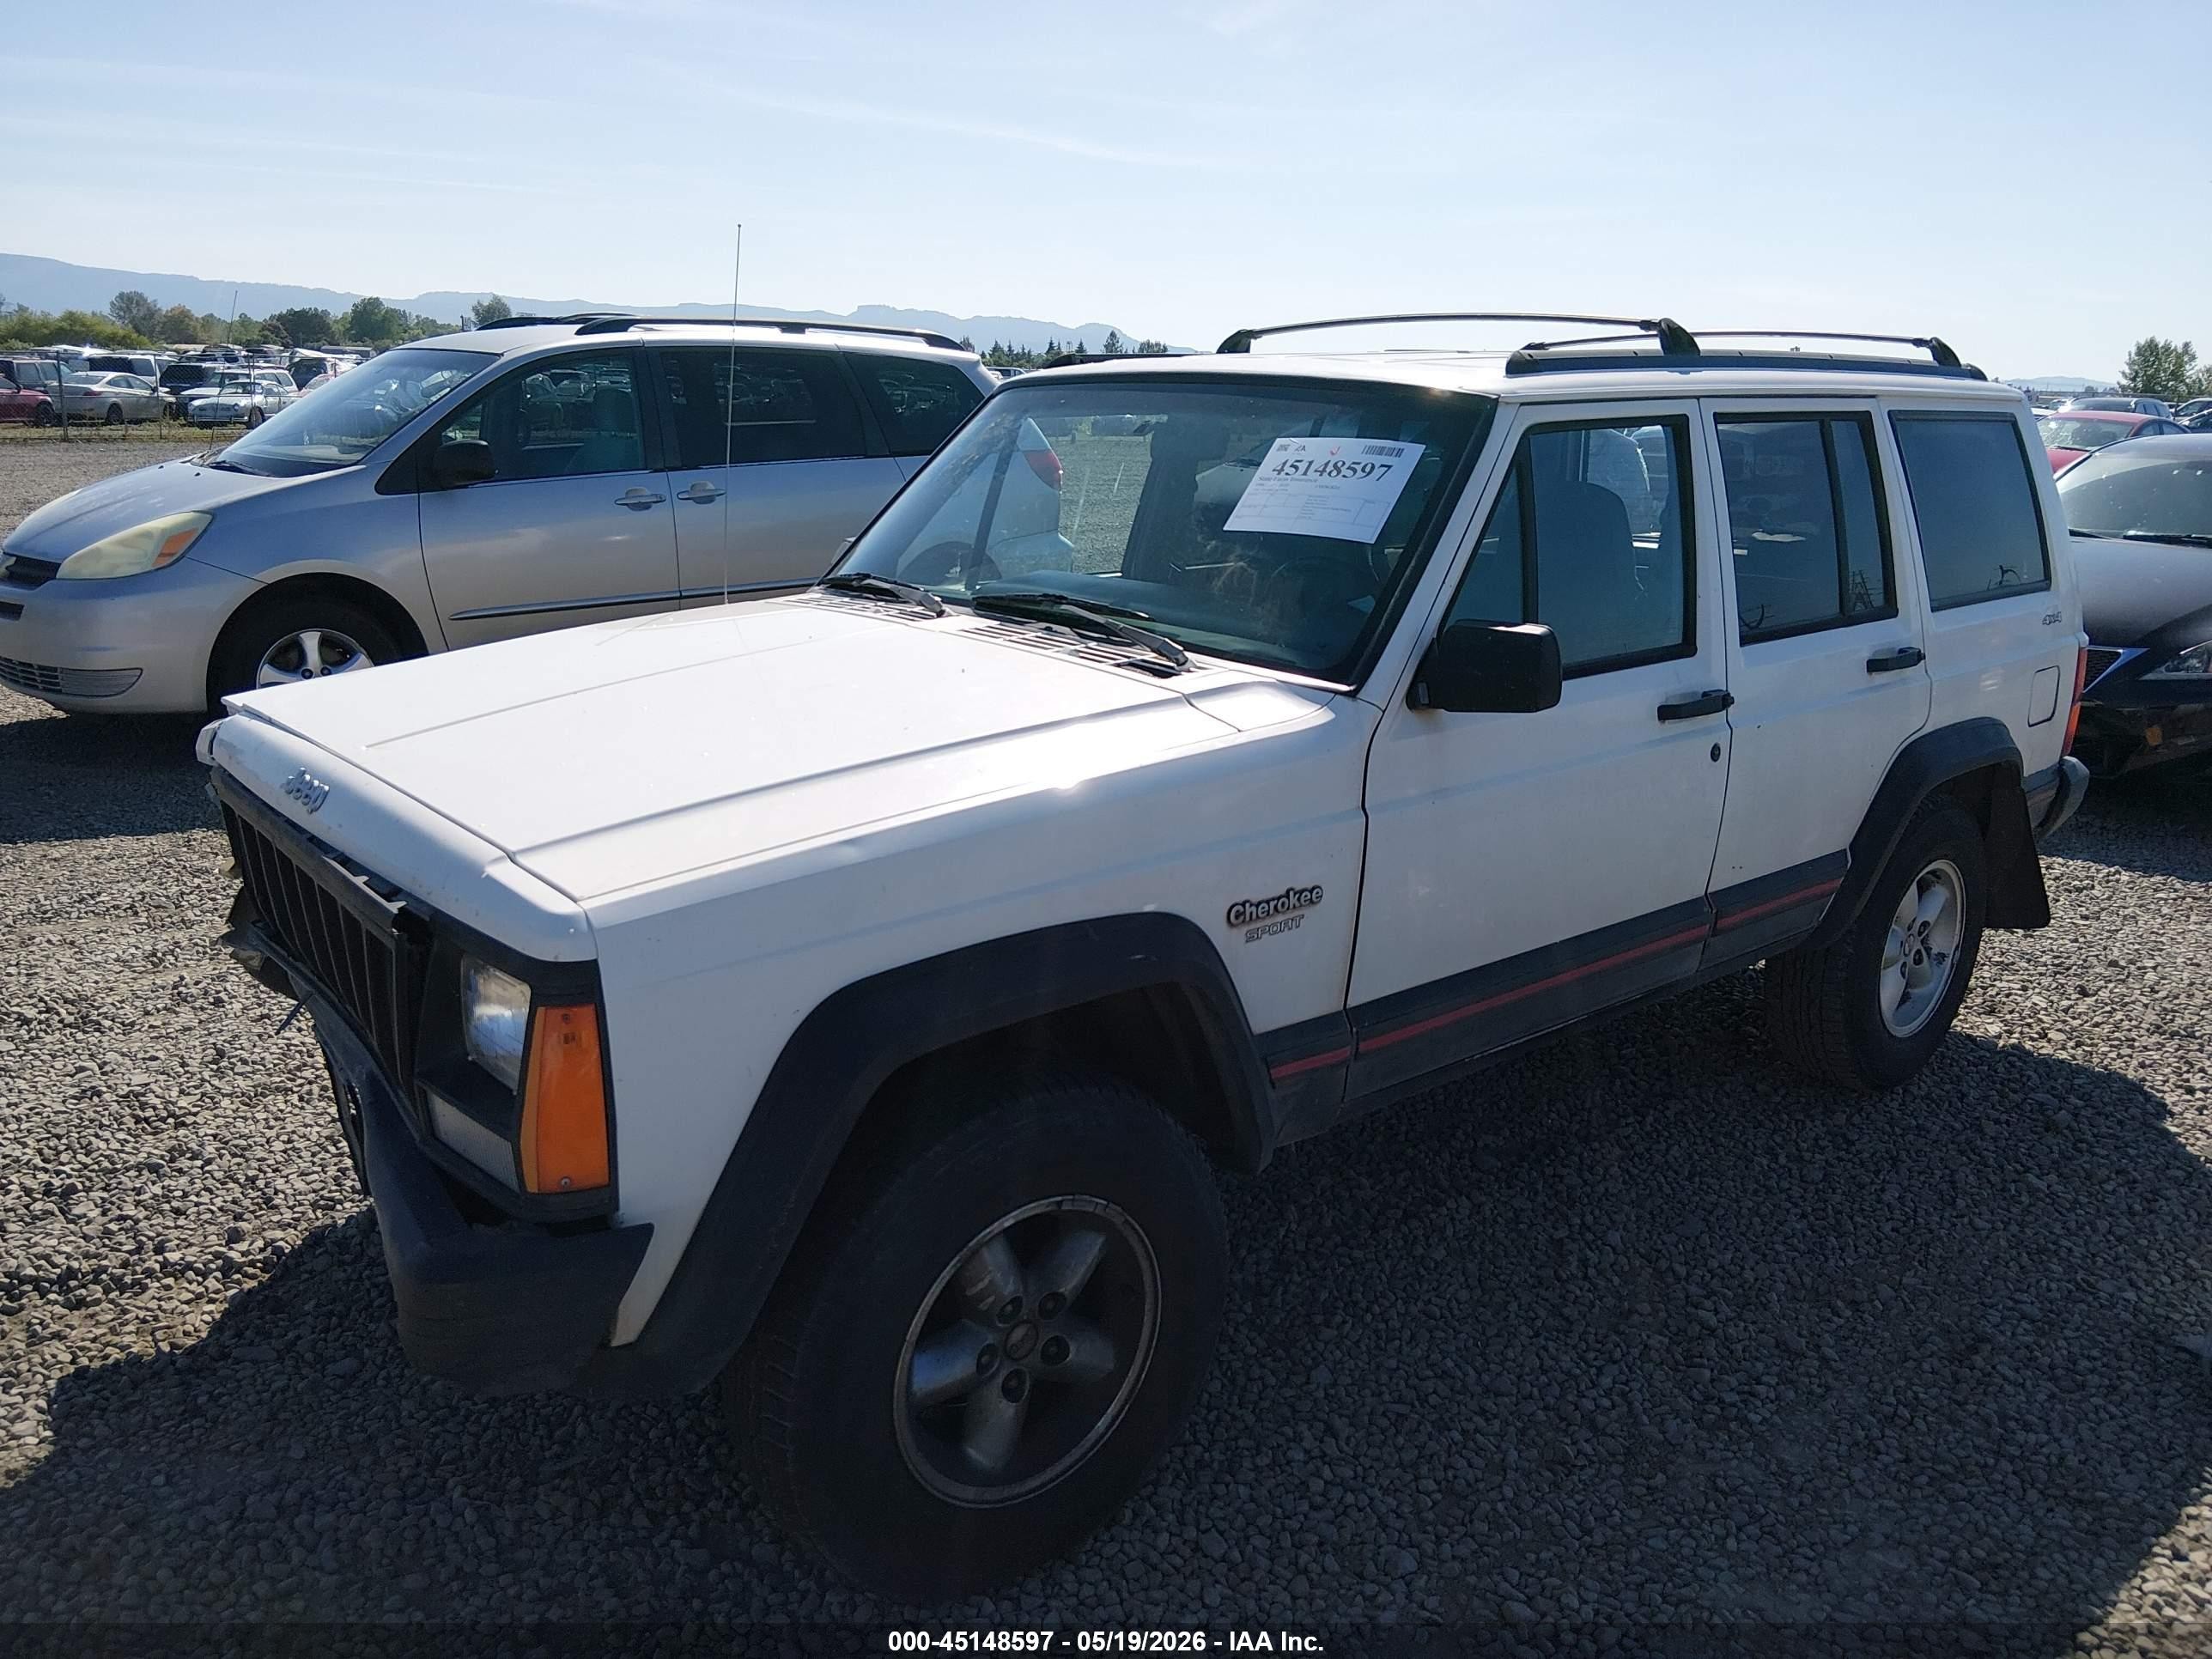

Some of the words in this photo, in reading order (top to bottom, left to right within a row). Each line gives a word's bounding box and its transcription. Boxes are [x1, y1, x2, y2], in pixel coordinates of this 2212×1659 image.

[1272, 459, 1394, 482] 45148597
[1226, 884, 1323, 928] Cherokee
[1244, 914, 1305, 943] SPORT
